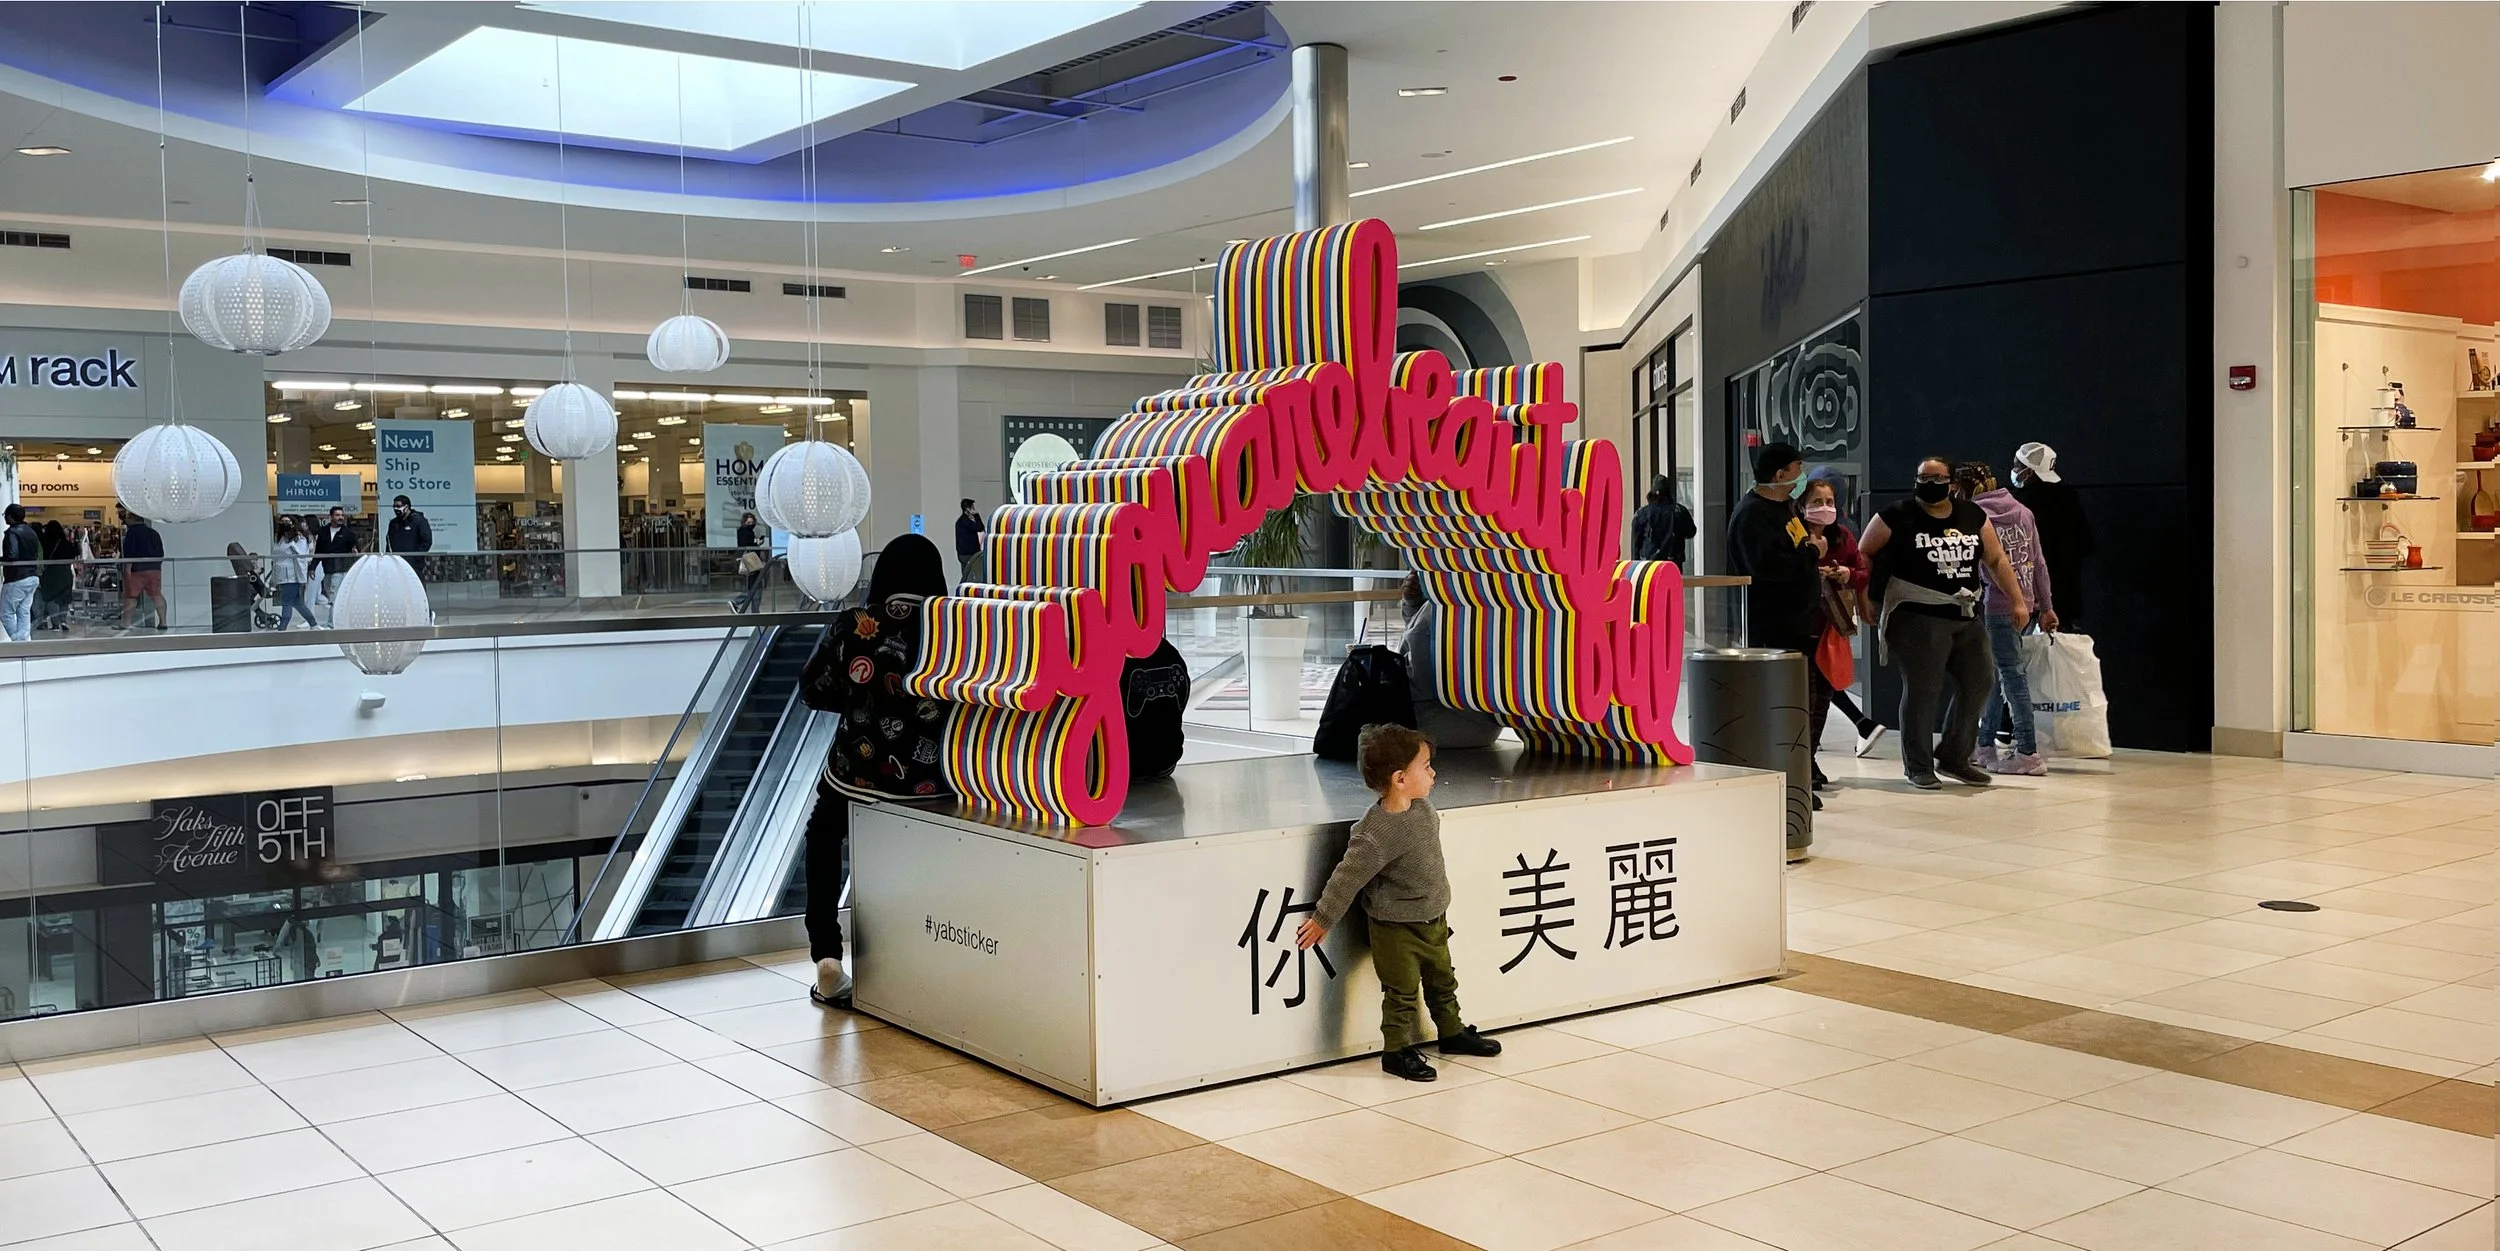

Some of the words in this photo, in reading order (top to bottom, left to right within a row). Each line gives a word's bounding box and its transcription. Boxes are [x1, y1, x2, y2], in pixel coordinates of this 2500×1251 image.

[30, 349, 138, 388] rack
[385, 434, 430, 449] New!
[385, 458, 420, 475] Ship
[716, 459, 767, 476] HOM
[41, 483, 79, 491] rooms
[294, 479, 321, 487] NOW
[386, 478, 404, 489] to
[408, 477, 451, 490] Store
[286, 488, 329, 496] HIRING!
[1915, 531, 1979, 548] flower
[1927, 545, 1975, 563] child
[2391, 592, 2415, 602] LE
[153, 805, 212, 841] Saks
[256, 795, 325, 832] OFF
[193, 823, 246, 855] Fifth
[154, 842, 239, 875] Avenue
[257, 826, 326, 863] 5TH
[1237, 836, 1680, 1016] 你美麗
[925, 914, 999, 956] #yabsticker
